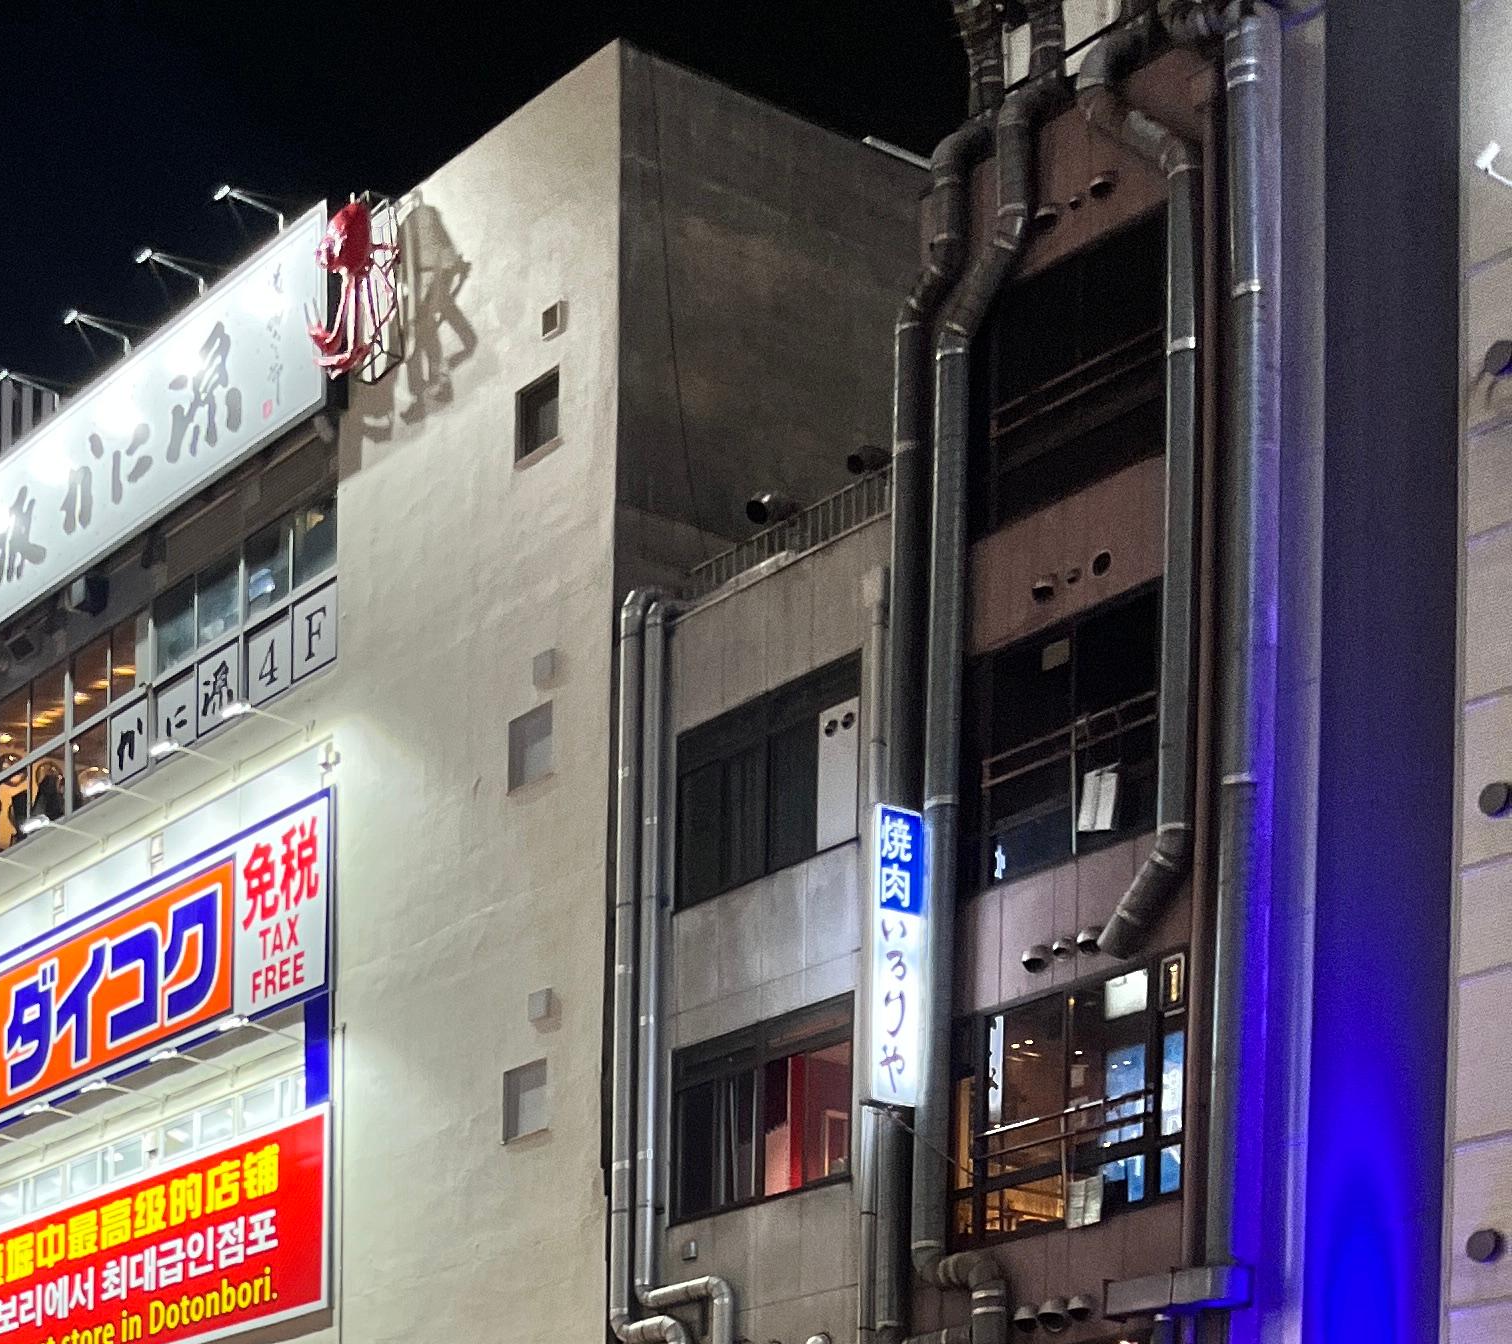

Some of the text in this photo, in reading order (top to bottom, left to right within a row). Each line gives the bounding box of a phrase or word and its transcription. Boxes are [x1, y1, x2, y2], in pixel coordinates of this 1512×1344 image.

[242, 816, 320, 932] 免税
[251, 951, 306, 1005] FREE
[258, 919, 300, 962] TAX
[880, 814, 913, 1094] 焼肉 いろりや
[4, 885, 222, 1092] ダイコク
[101, 1209, 279, 1300] 최대급인점포
[121, 1310, 142, 1343] in
[149, 1266, 279, 1336] Dotonbori.
